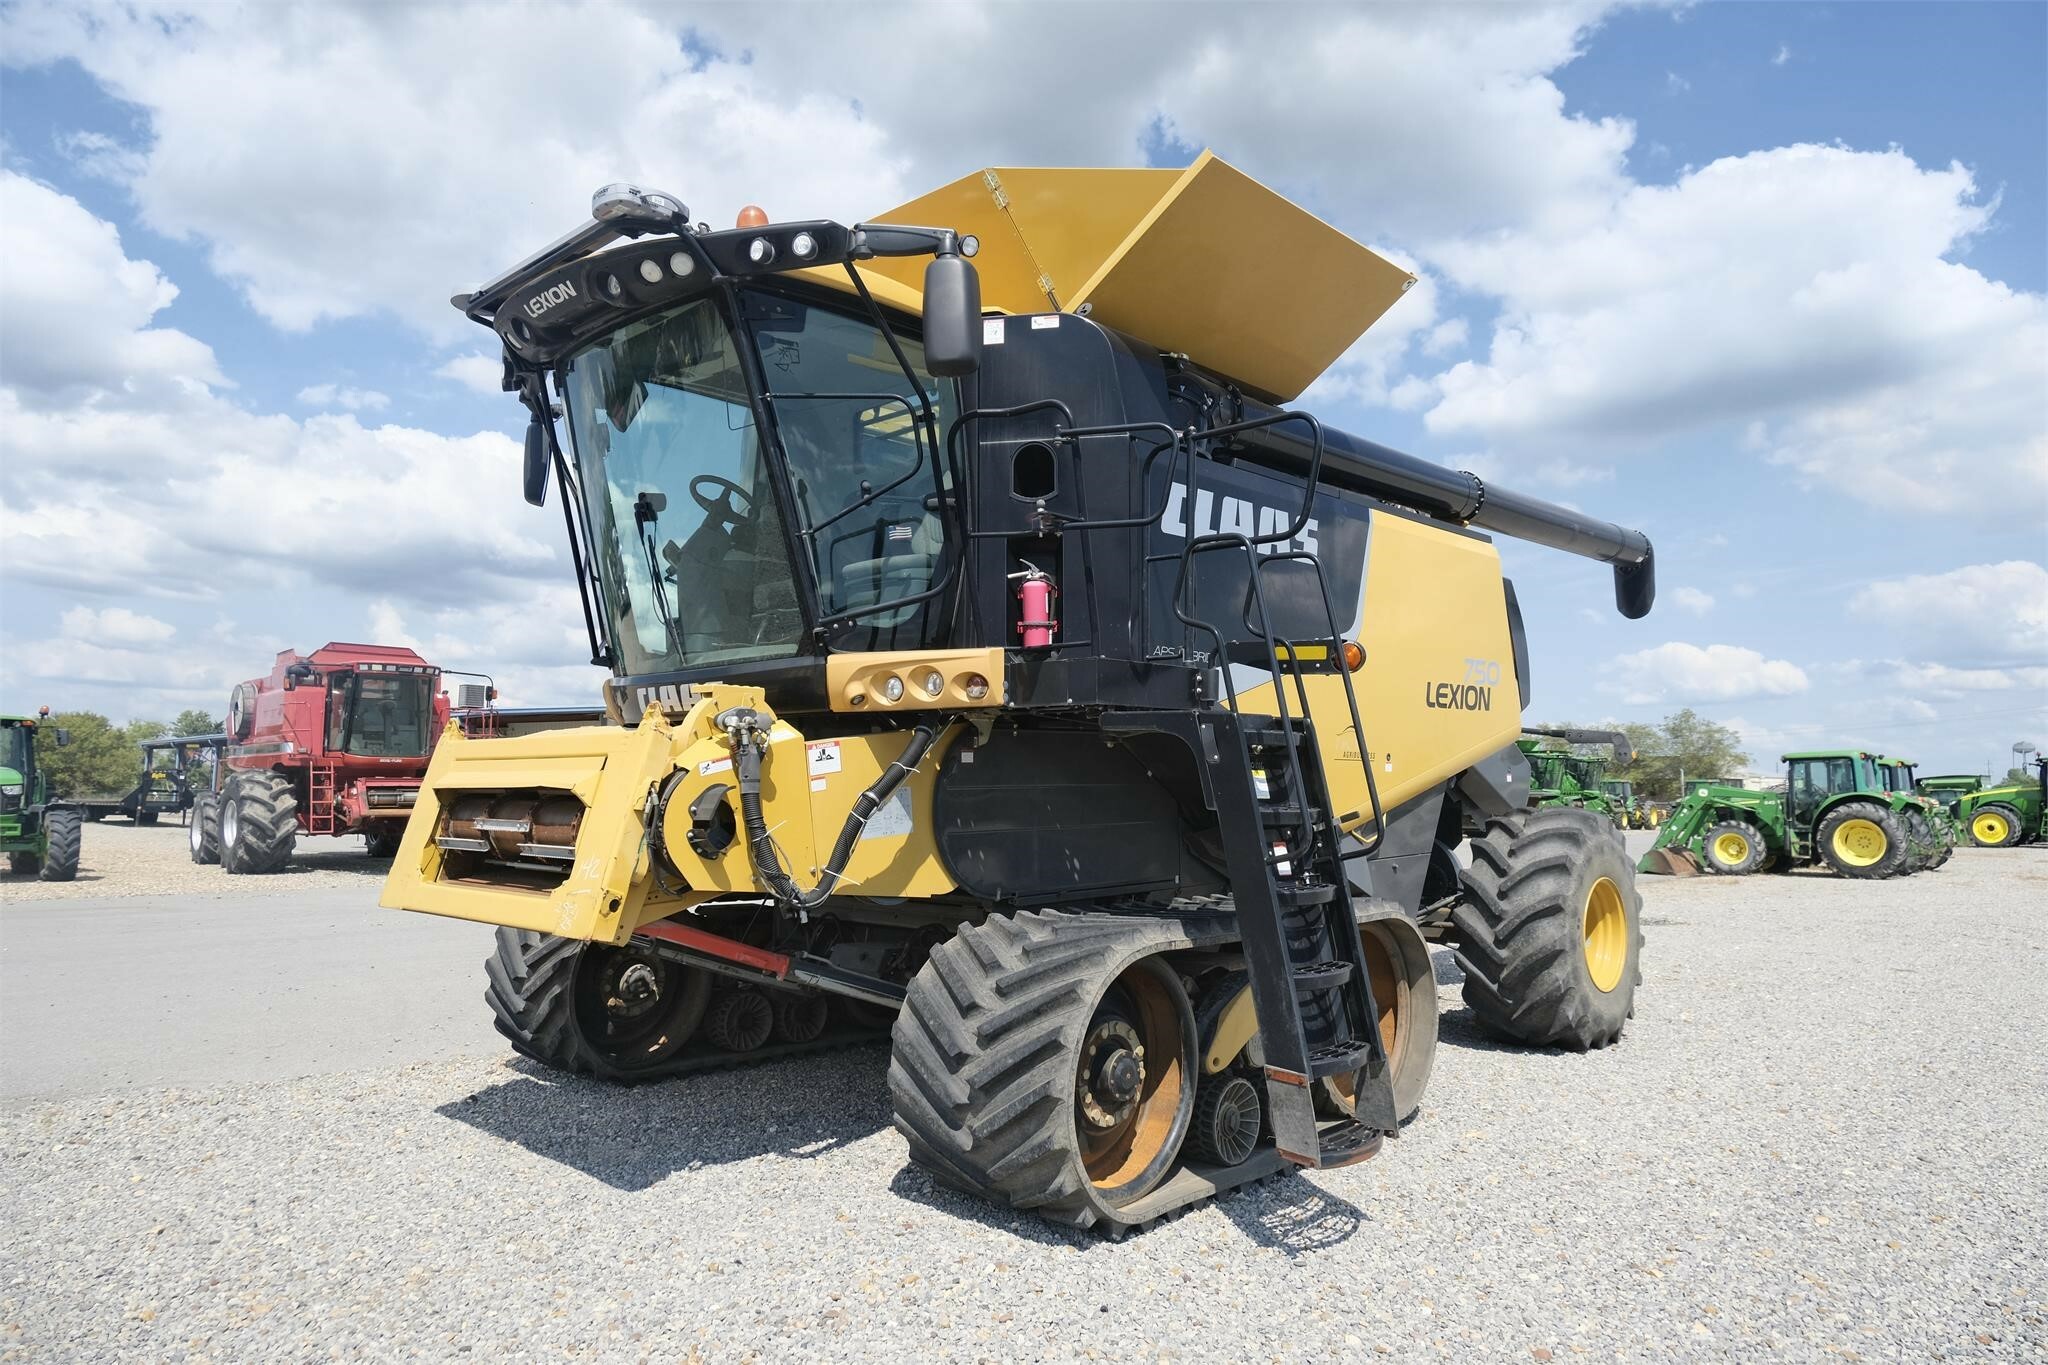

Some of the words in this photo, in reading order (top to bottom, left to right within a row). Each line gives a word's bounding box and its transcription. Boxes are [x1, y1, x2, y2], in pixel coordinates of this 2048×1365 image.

[523, 279, 577, 318] LEXION
[1160, 481, 1319, 565] CLAAS
[1153, 645, 1176, 656] APS
[1462, 658, 1500, 686] 750
[636, 681, 724, 714] CLAA
[1426, 681, 1491, 711] LEXION
